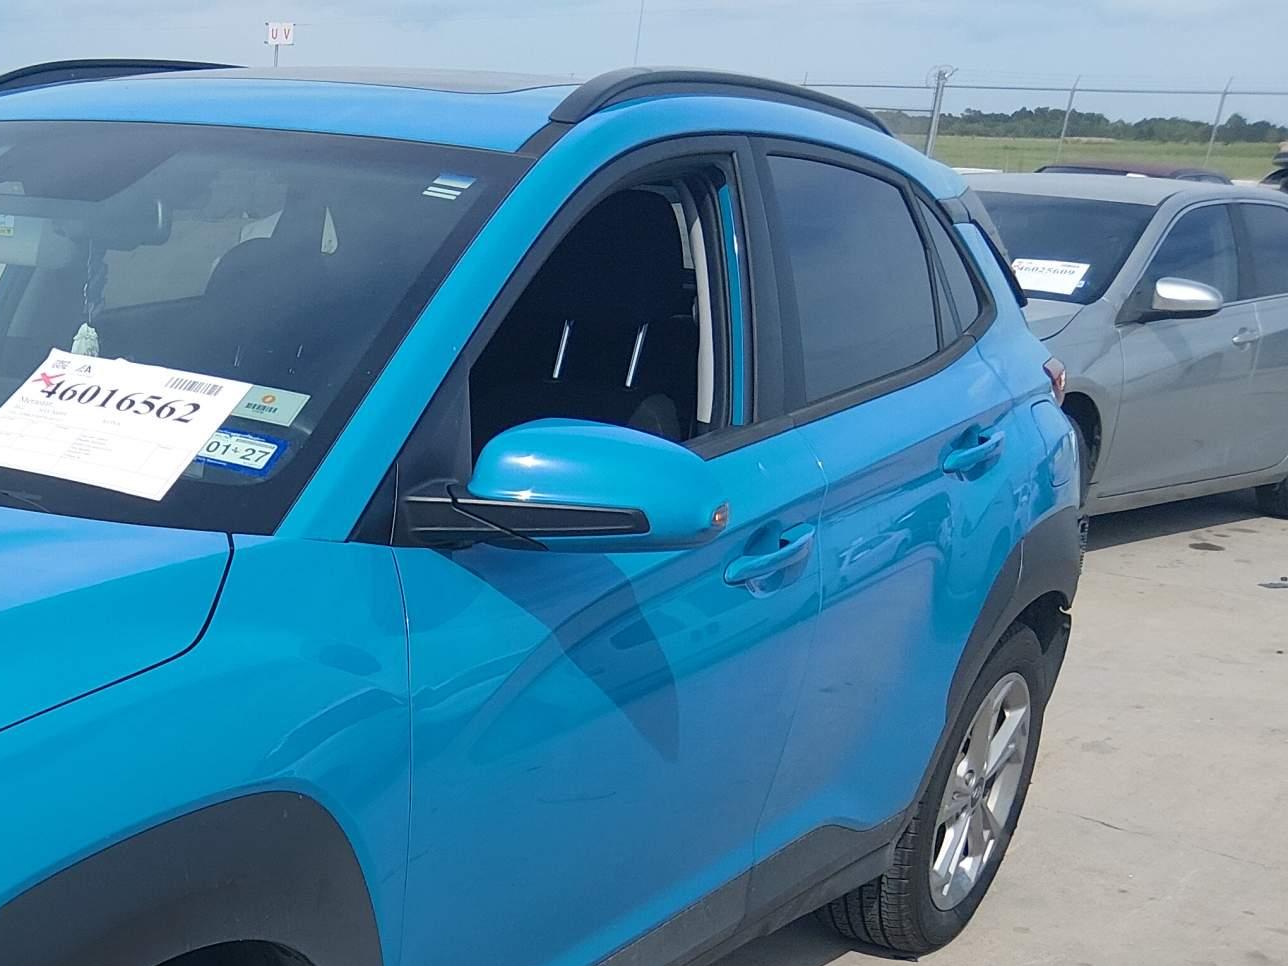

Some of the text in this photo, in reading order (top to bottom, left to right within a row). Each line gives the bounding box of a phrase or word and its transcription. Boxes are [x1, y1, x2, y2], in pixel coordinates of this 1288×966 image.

[271, 27, 290, 40] U V
[40, 379, 200, 424] 46016562
[206, 440, 231, 456] 01
[240, 447, 270, 463] 27
